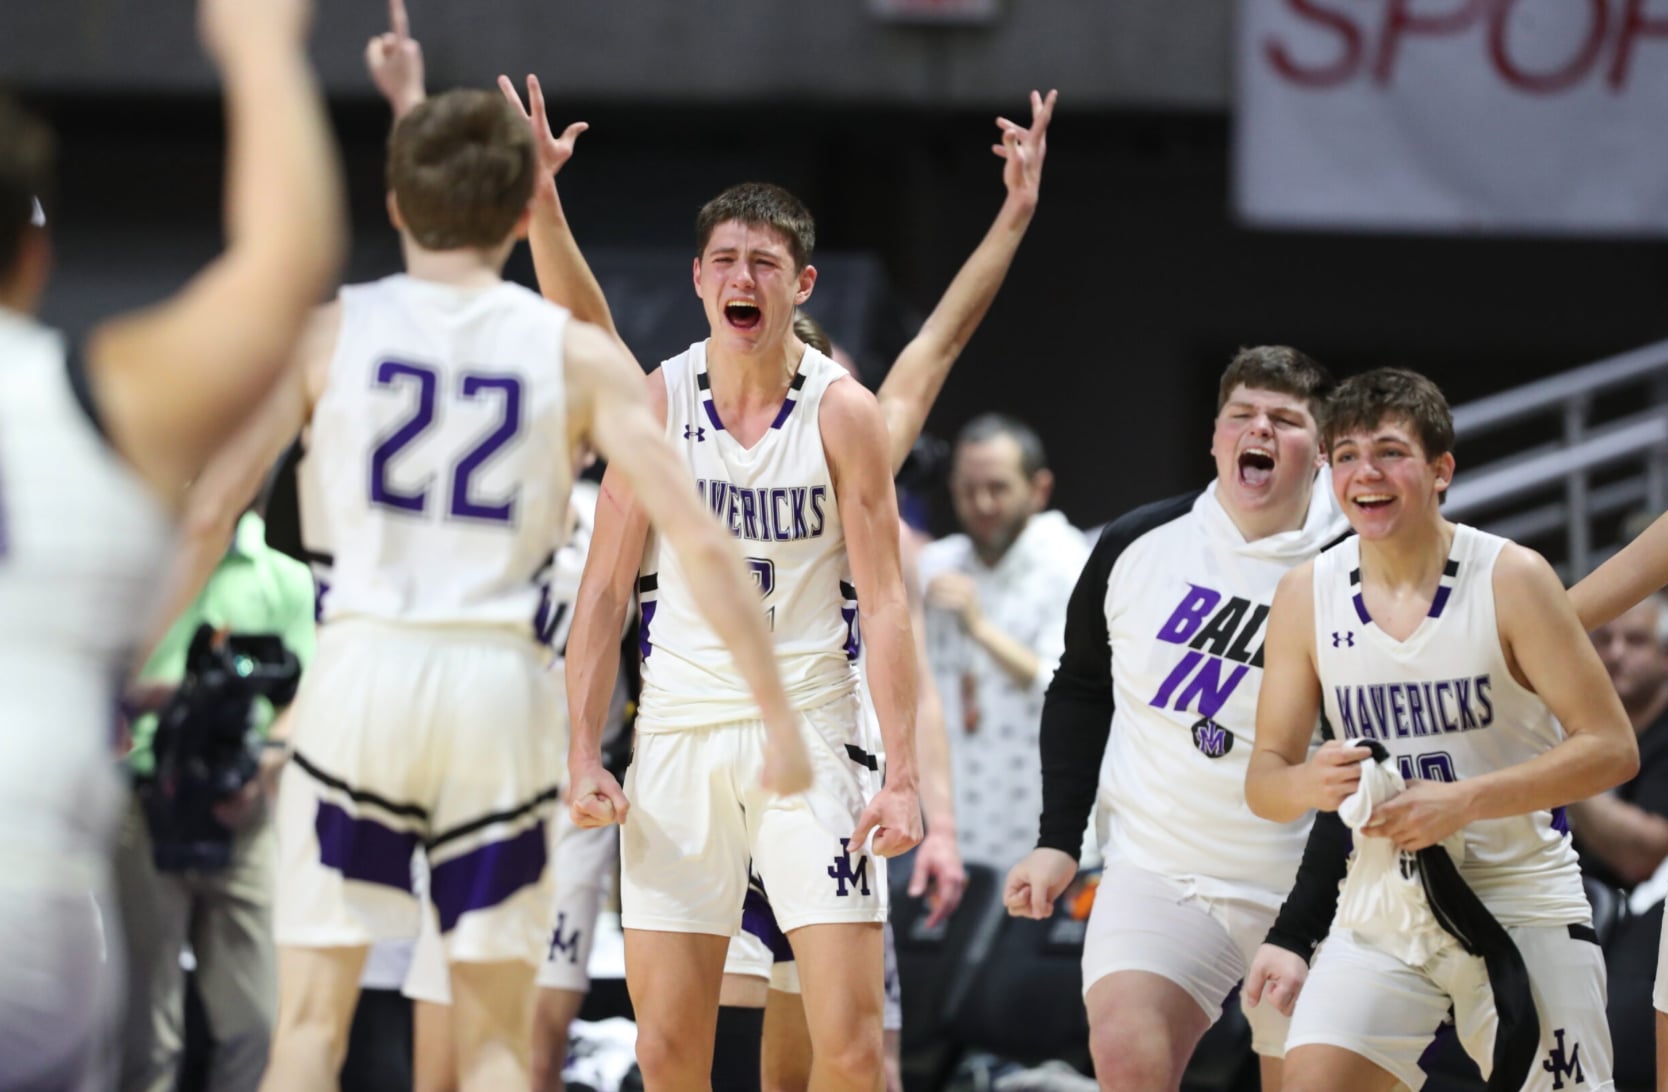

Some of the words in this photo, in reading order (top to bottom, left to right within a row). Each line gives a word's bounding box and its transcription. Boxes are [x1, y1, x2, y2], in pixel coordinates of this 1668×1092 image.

[368, 357, 528, 523] 22
[1156, 582, 1271, 668] BAL
[1148, 650, 1249, 719] IN
